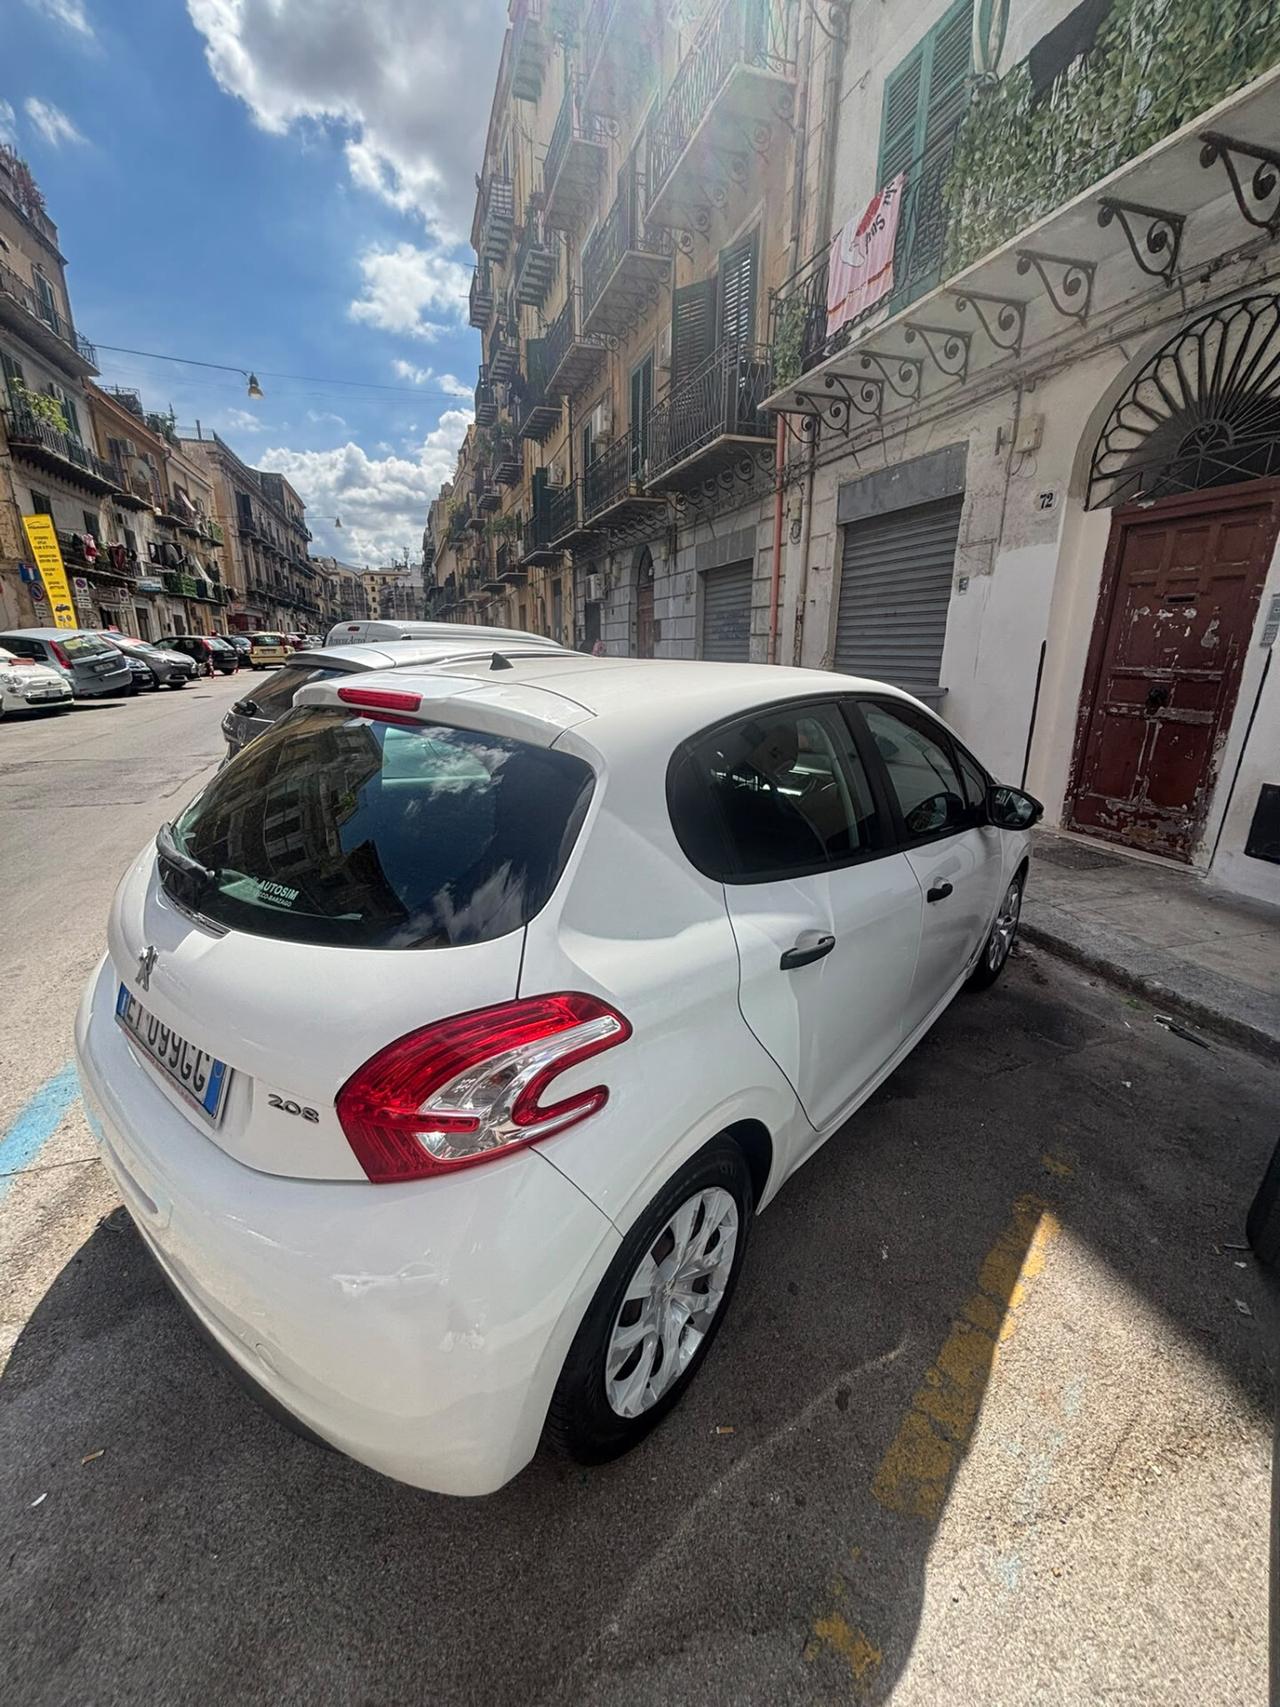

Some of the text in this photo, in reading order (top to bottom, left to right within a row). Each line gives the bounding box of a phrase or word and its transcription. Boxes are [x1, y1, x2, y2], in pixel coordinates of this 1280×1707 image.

[1040, 492, 1054, 510] 72
[257, 879, 300, 901] AUTOSIM
[267, 1093, 320, 1124] 208
